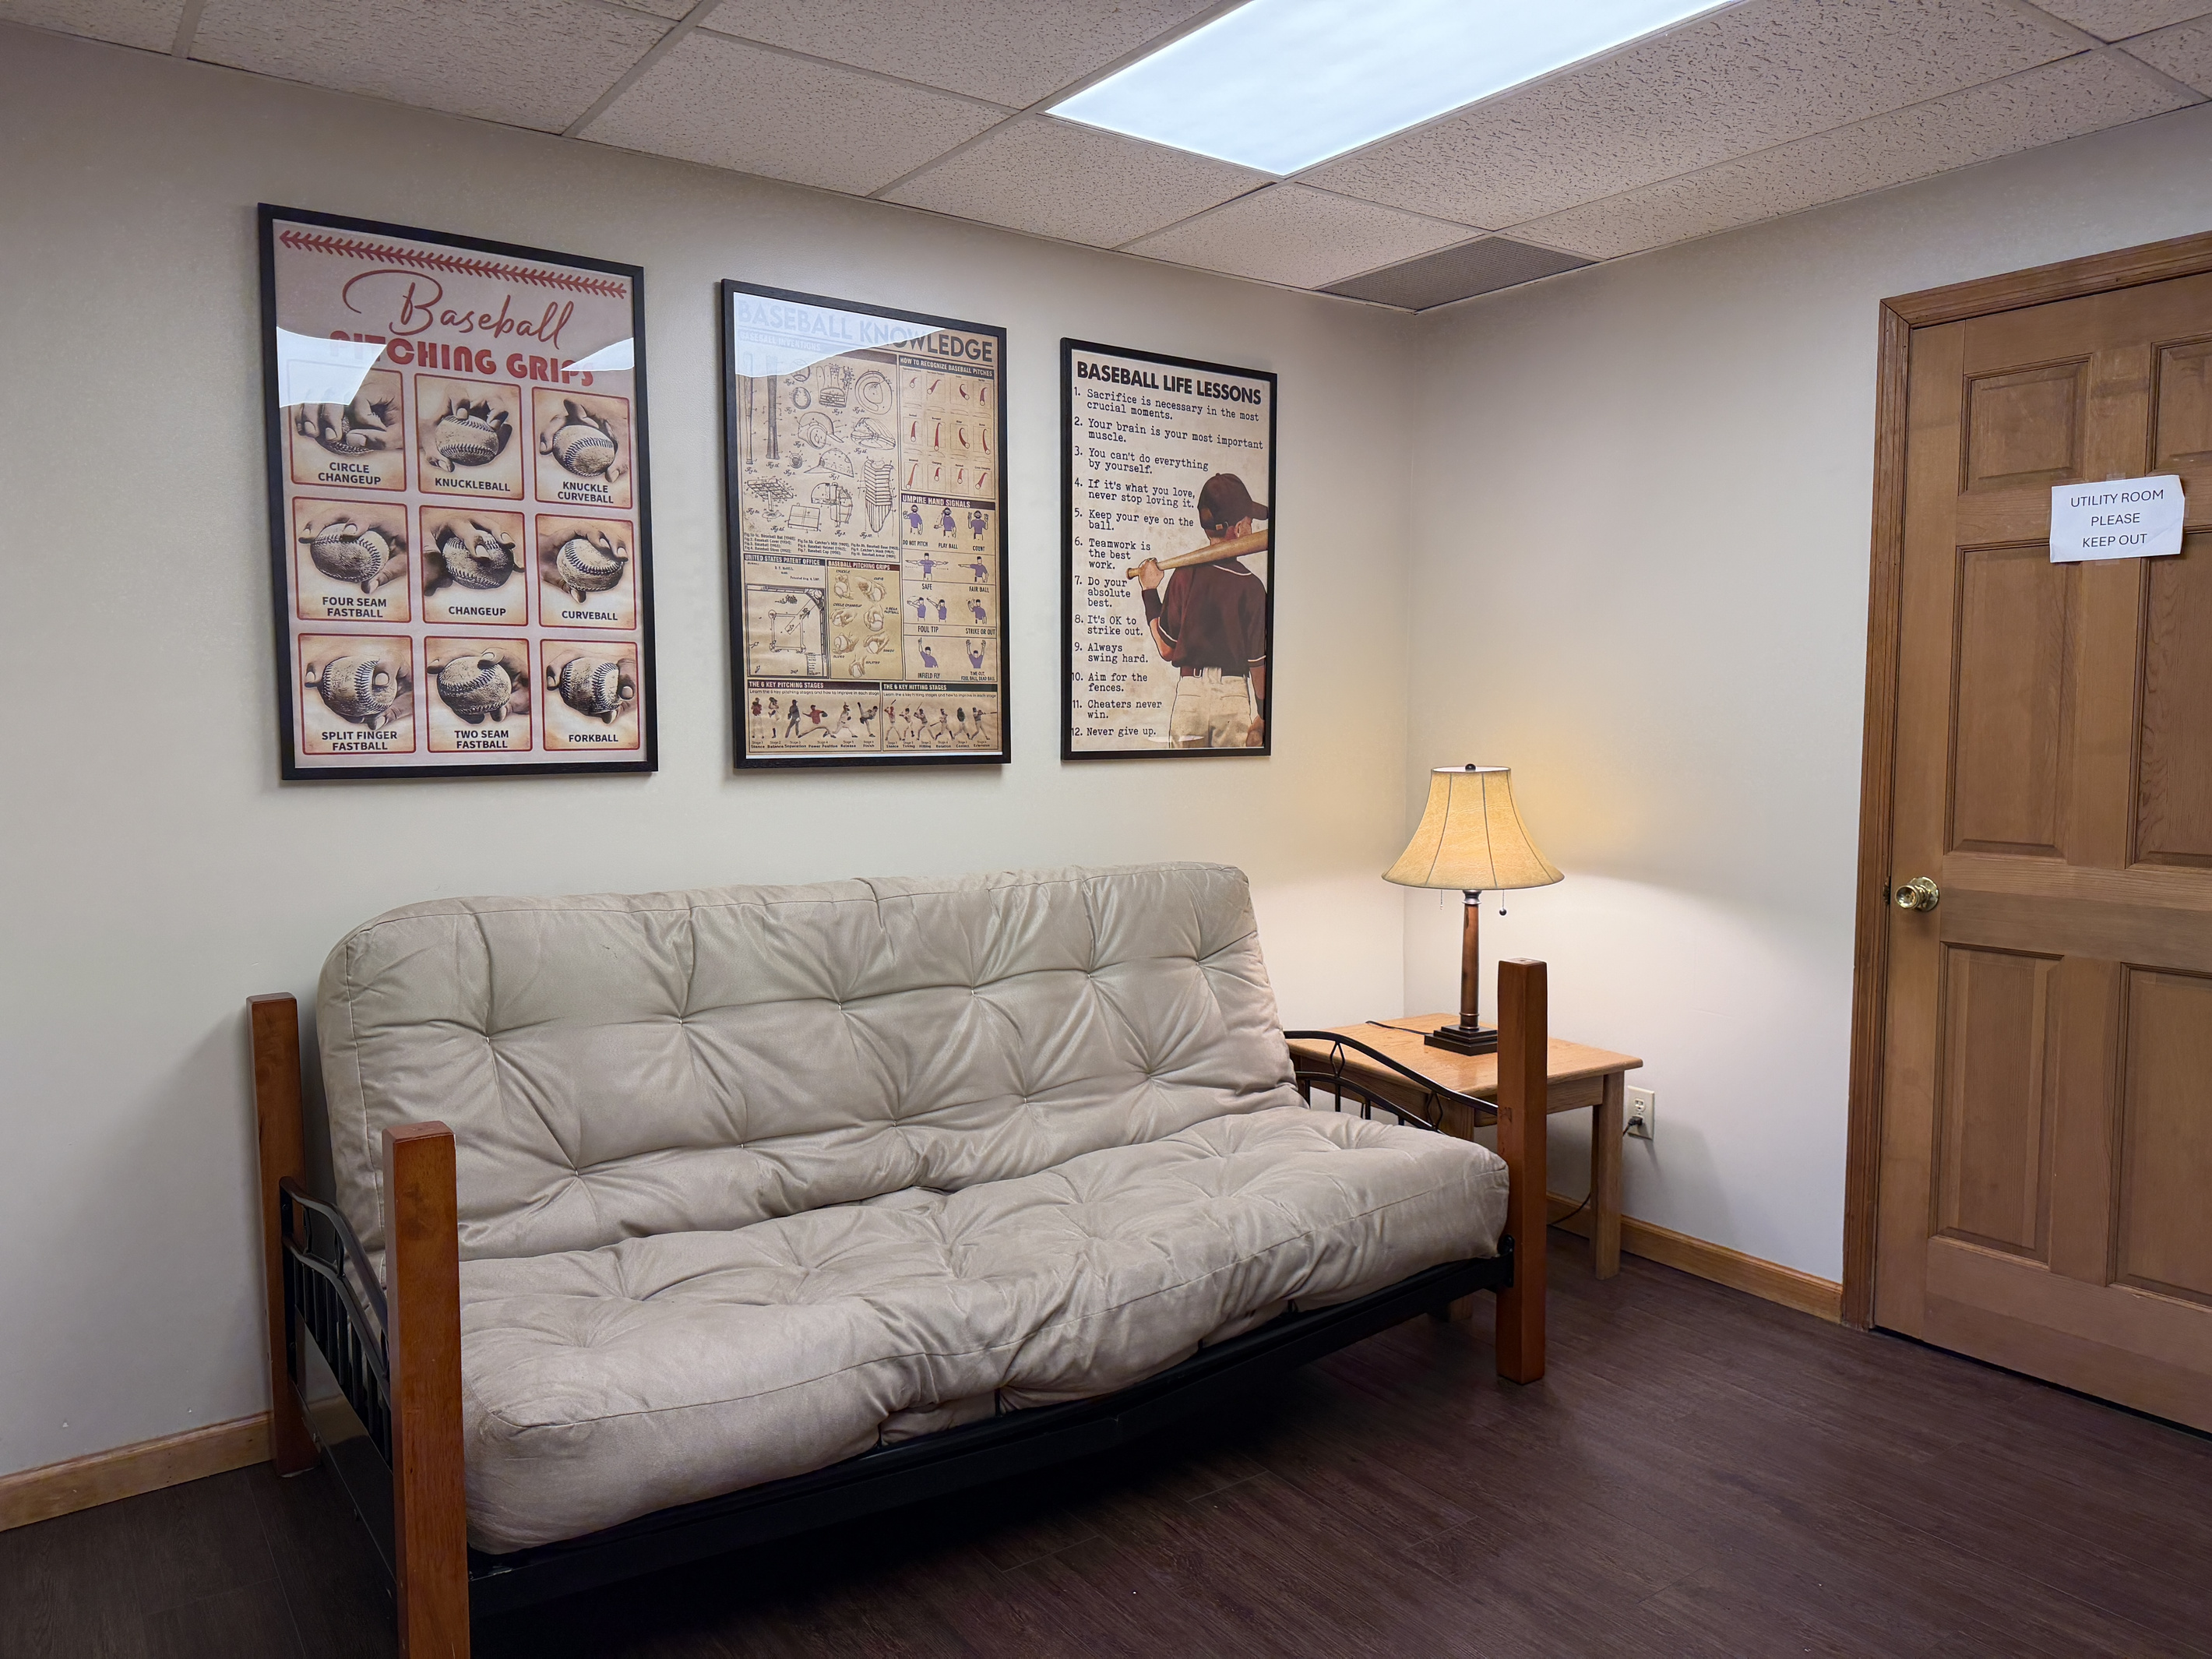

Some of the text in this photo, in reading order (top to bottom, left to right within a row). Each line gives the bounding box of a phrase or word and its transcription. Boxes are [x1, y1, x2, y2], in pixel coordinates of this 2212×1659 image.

[343, 269, 575, 350] Baseball
[738, 300, 993, 362] BASEBALL KNOWLEDGE
[506, 353, 594, 387] GRIPS
[921, 361, 947, 369] RECOGNIZE
[1077, 361, 1261, 405] BASEBALL LIFE LESSONS
[1074, 387, 1259, 421] 1. Sacrifice is necessary in the most
[1087, 400, 1173, 420] crucial moments.
[1074, 417, 1263, 449] 2. Your brain is your most important
[1089, 431, 1126, 442] muscle.
[1075, 446, 1209, 471] 3. You can't do everything
[329, 462, 369, 474] CIRCLE
[1089, 459, 1152, 474] by yourself.
[318, 472, 381, 486] CHANGEUP
[435, 477, 510, 492] KNUCKLEBALL
[563, 481, 608, 494] KNUCKLE
[1075, 478, 1195, 498] 4. If it's what you love,
[558, 491, 614, 504] CURVEBALL
[903, 495, 926, 503] UMPIRE
[1089, 491, 1194, 509] never stop loving it.
[2071, 489, 2164, 507] UTILITY ROOM
[1075, 508, 1194, 527] 5. Keep your eye on the
[2091, 512, 2140, 527] PLEASE
[1089, 520, 1114, 530] ball.
[1075, 537, 1150, 551] 6. Teamwork is
[2083, 534, 2147, 548] KEEP OUT
[1089, 549, 1131, 559] the best
[1089, 560, 1115, 569] work.
[1075, 576, 1127, 588] 7. Do your
[1088, 588, 1130, 597] absolute
[322, 597, 387, 608] FOUR SEAM
[1088, 598, 1112, 607] best.
[327, 607, 383, 618] FASTBALL
[449, 605, 506, 616] CHANGEUP
[562, 610, 618, 621] CURVEBALL
[1075, 615, 1083, 623] 8.
[1087, 615, 1105, 624] It's
[1110, 616, 1122, 625] OK
[1087, 626, 1143, 636] strike out.
[1075, 643, 1122, 653] 9. Always
[1088, 653, 1148, 664] swing hard.
[1072, 672, 1083, 682] 10.
[1088, 673, 1106, 682] Aim
[1111, 673, 1128, 682] for
[1089, 683, 1124, 692] fences.
[1073, 699, 1082, 709] 11.
[1088, 699, 1132, 709] Cheaters
[1087, 710, 1108, 719] win.
[322, 730, 397, 740] SPLIT FINGER
[454, 729, 509, 739] TWO SEAM
[569, 733, 618, 742] FORKBALL
[1072, 727, 1156, 737] 12. Never give up.
[333, 740, 388, 751] FASTBALL
[456, 739, 508, 748] FASTBALL
